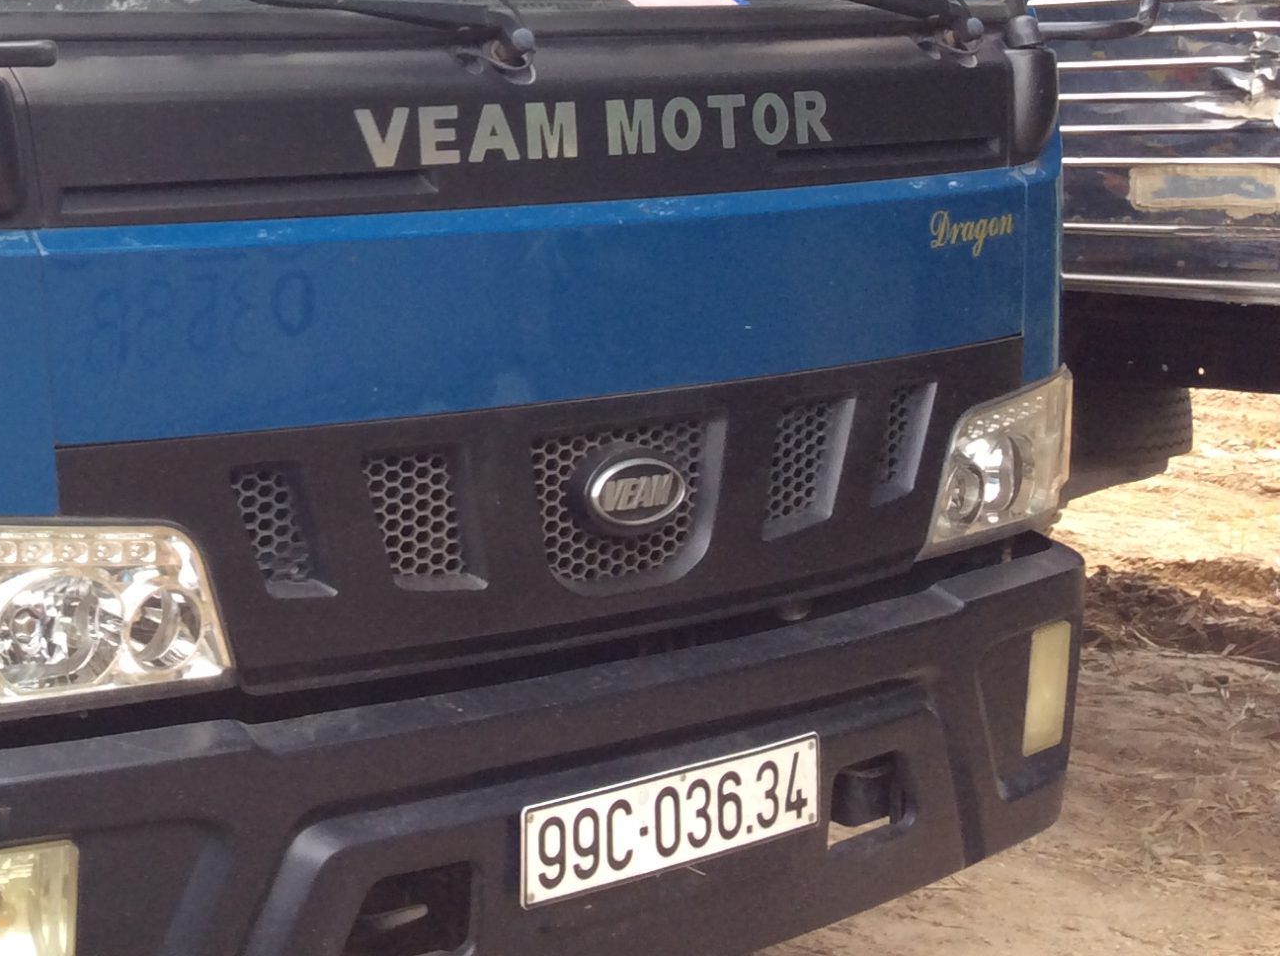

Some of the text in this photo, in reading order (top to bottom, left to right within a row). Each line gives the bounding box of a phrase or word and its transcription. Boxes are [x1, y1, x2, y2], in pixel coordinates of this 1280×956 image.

[354, 90, 832, 168] VEAM MOTOR
[930, 210, 1012, 257] Dragon
[604, 471, 674, 512] VEAM
[538, 752, 808, 890] 99C-036.34
